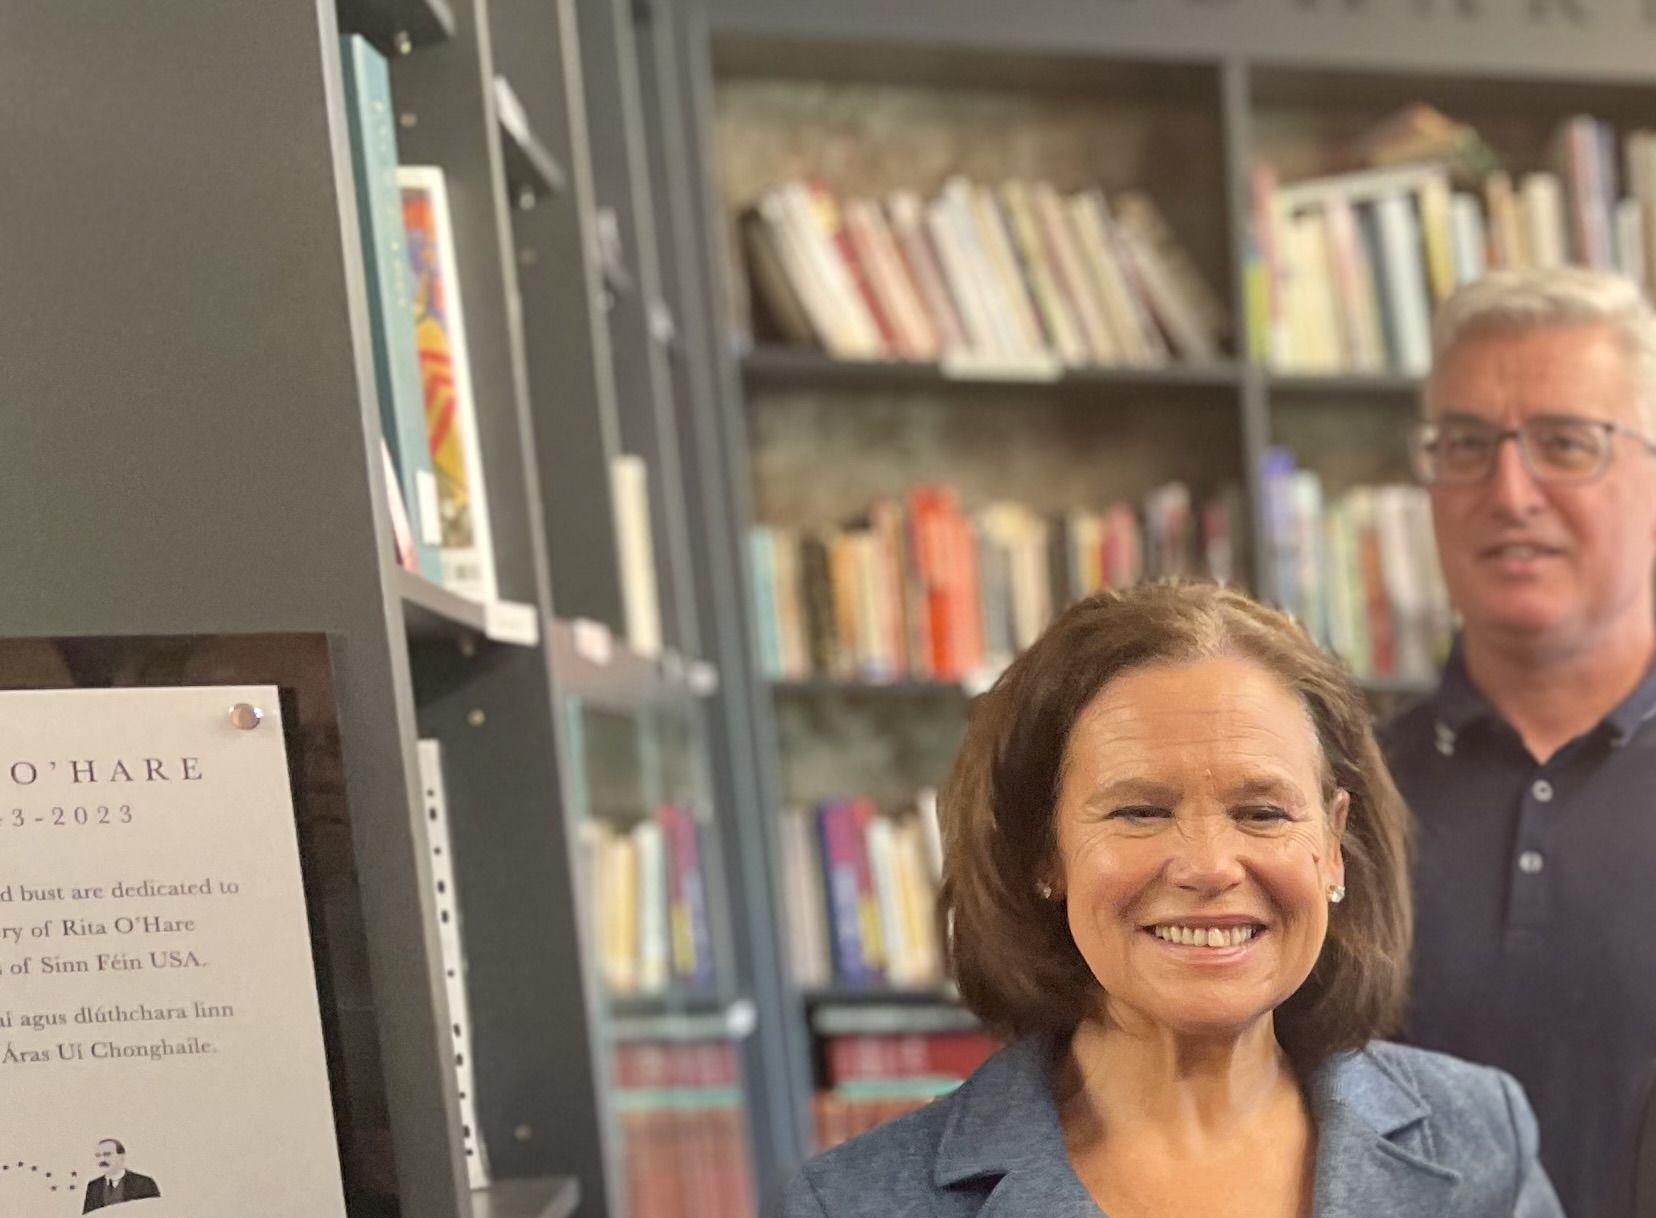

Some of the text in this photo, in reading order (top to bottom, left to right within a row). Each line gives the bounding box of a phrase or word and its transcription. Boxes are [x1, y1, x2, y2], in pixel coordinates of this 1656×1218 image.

[0, 804, 134, 828] 3-2023
[19, 885, 65, 903] bust
[71, 885, 103, 901] are
[111, 877, 213, 900] dedicated
[219, 882, 240, 896] to
[31, 919, 53, 939] of
[62, 919, 107, 937] Rita
[10, 957, 32, 976] of
[41, 954, 89, 974] Sinn
[96, 953, 143, 972] Féin
[149, 950, 209, 970] USA.
[20, 1013, 67, 1031] agus
[73, 1003, 188, 1024] dlúthchara
[2, 1041, 50, 1065] Áras
